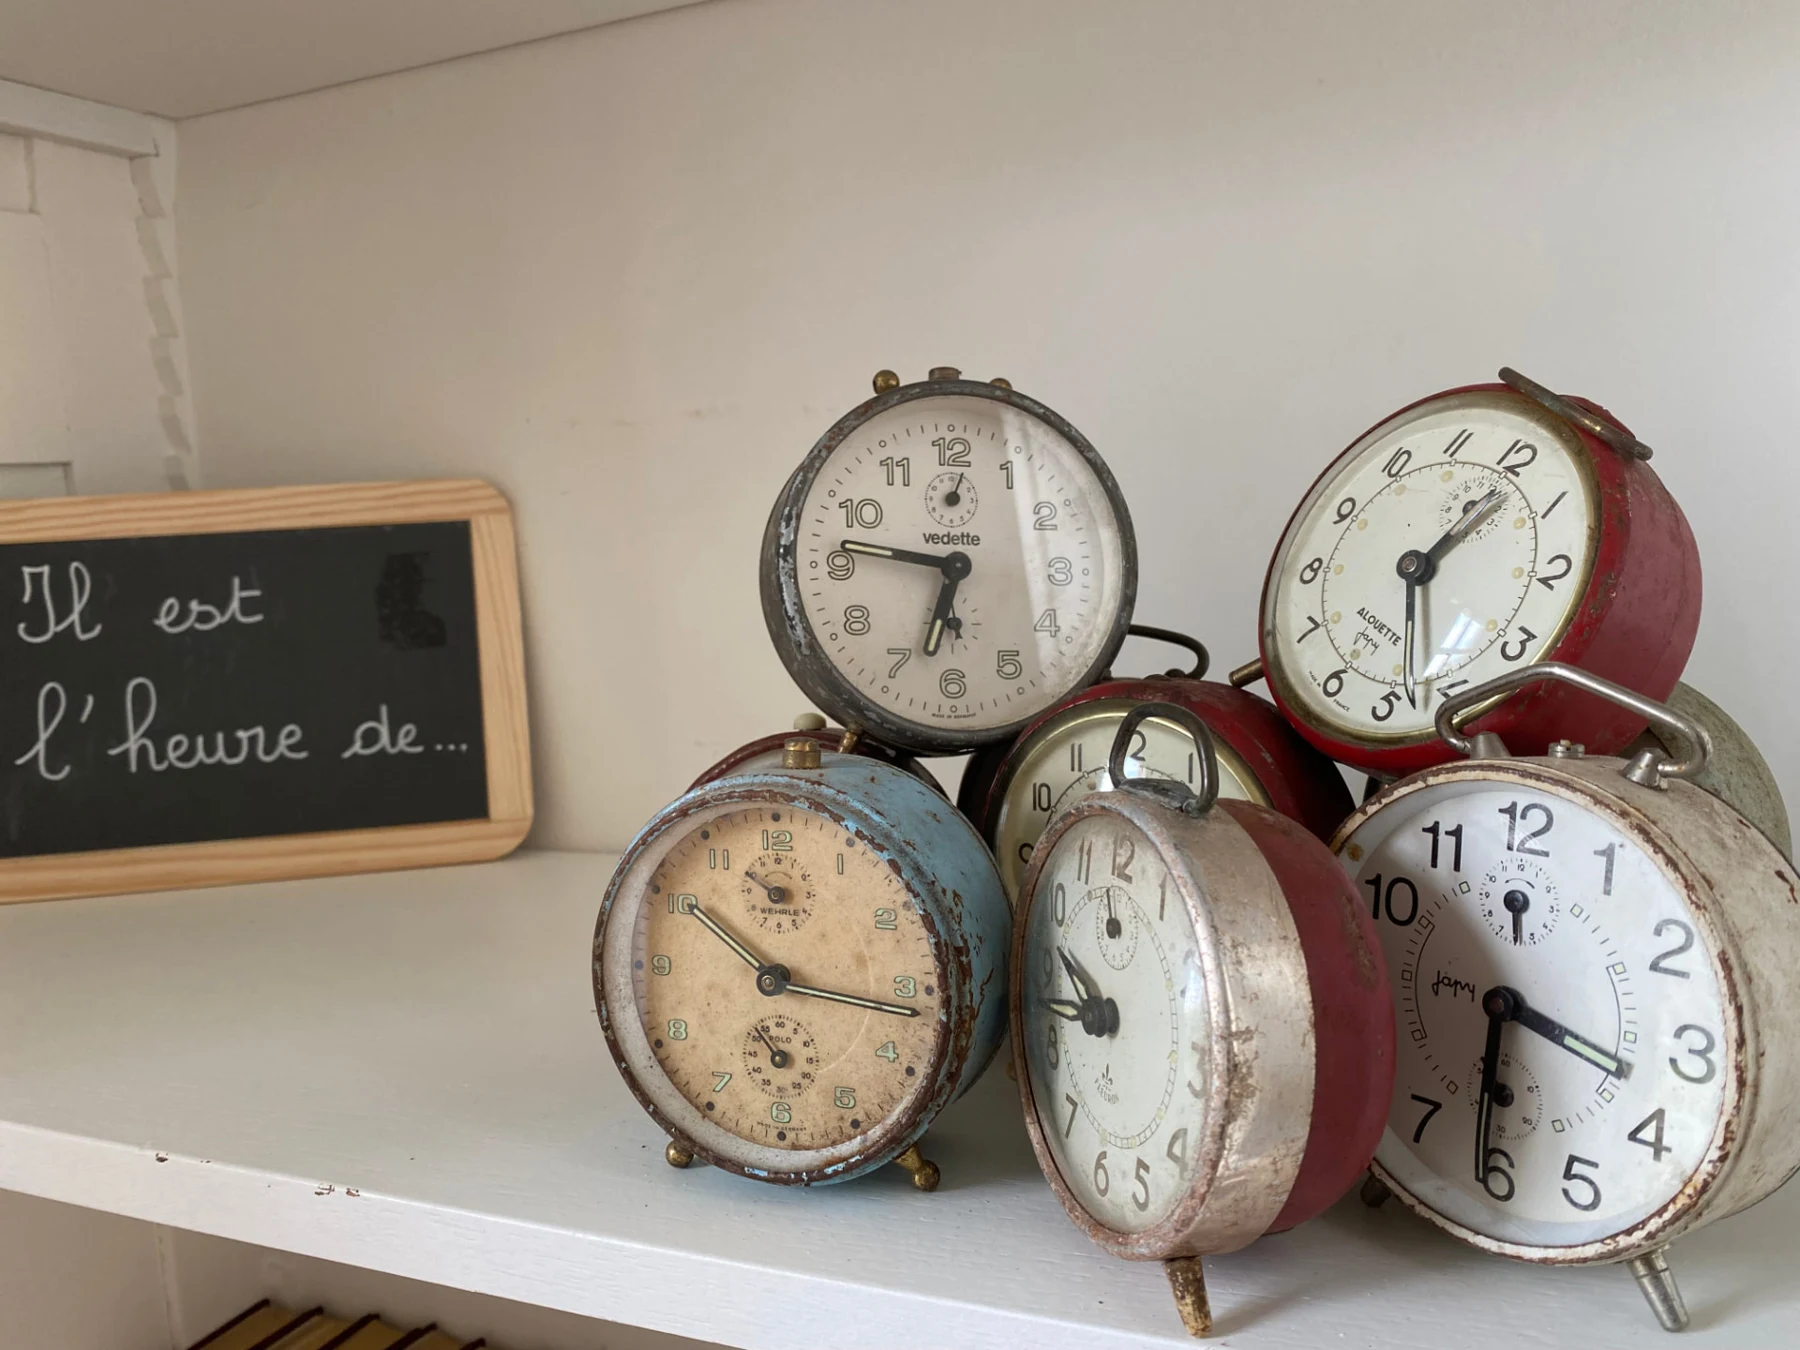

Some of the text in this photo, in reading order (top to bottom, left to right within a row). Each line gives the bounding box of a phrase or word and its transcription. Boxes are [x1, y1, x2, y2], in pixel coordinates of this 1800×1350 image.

[932, 437, 971, 467] 12
[1443, 428, 1474, 457] 11
[880, 456, 910, 487] 11
[1381, 446, 1413, 479] 10
[1496, 439, 1538, 478] 12
[1000, 460, 1014, 489] 1
[839, 499, 883, 529] 10
[1033, 501, 1058, 530] 2
[1332, 497, 1357, 525] 9
[1541, 490, 1569, 519] 1
[922, 531, 981, 546] vedette
[826, 550, 855, 580] 9
[1047, 557, 1073, 586] 3
[1299, 557, 1323, 585] 8
[1535, 554, 1572, 591] 2
[17, 561, 264, 643] Il est
[843, 605, 871, 636] 8
[1034, 609, 1060, 637] 4
[1296, 615, 1321, 644] 7
[1356, 607, 1402, 647] ALOUETTE
[1500, 625, 1538, 662] 3
[887, 648, 911, 678] 7
[996, 650, 1022, 680] 5
[939, 669, 966, 699] 6
[1322, 669, 1349, 698] 6
[1371, 690, 1402, 721] 5
[15, 677, 468, 780] l'heure de...
[1070, 743, 1082, 772] 11
[1188, 752, 1194, 784] 1
[1032, 782, 1051, 812] 10
[762, 830, 793, 852] 12
[1497, 801, 1554, 857] 12
[709, 849, 729, 870] 11
[1076, 836, 1093, 885] 11
[1111, 833, 1136, 884] 12
[1421, 820, 1463, 872] 11
[837, 853, 844, 875] 1
[1501, 865, 1508, 873] 11
[1517, 863, 1525, 872] 12
[1593, 842, 1617, 896] 1
[668, 894, 697, 914] 10
[1048, 882, 1066, 928] 10
[1158, 872, 1169, 922] 1
[1364, 873, 1419, 927] 10
[1484, 891, 1490, 899] 9
[1548, 905, 1555, 913] 3
[760, 907, 800, 917] WEHRLE
[874, 907, 898, 930] 2
[1487, 909, 1493, 918] 8
[1499, 924, 1504, 933] 7
[1529, 932, 1535, 940] 5
[1648, 918, 1695, 979] 2
[651, 955, 671, 976] 9
[893, 976, 917, 998] 3
[667, 1018, 688, 1040] 8
[769, 1035, 792, 1044] POLO
[775, 1021, 786, 1029] 60
[793, 1027, 798, 1035] 5
[748, 1050, 758, 1058] 45
[875, 1041, 899, 1063] 4
[1047, 1023, 1059, 1071] 8
[1669, 1024, 1716, 1085] 3
[712, 1071, 732, 1093] 7
[752, 1066, 762, 1074] 40
[761, 1079, 772, 1087] 35
[834, 1086, 856, 1109] 5
[770, 1101, 792, 1124] 6
[1065, 1092, 1079, 1139] 7
[1410, 1093, 1442, 1144] 7
[1627, 1107, 1673, 1162] 4
[1093, 1150, 1110, 1198] 6
[1131, 1156, 1150, 1213] 5
[1483, 1147, 1516, 1202] 6
[1561, 1154, 1601, 1212] 5
